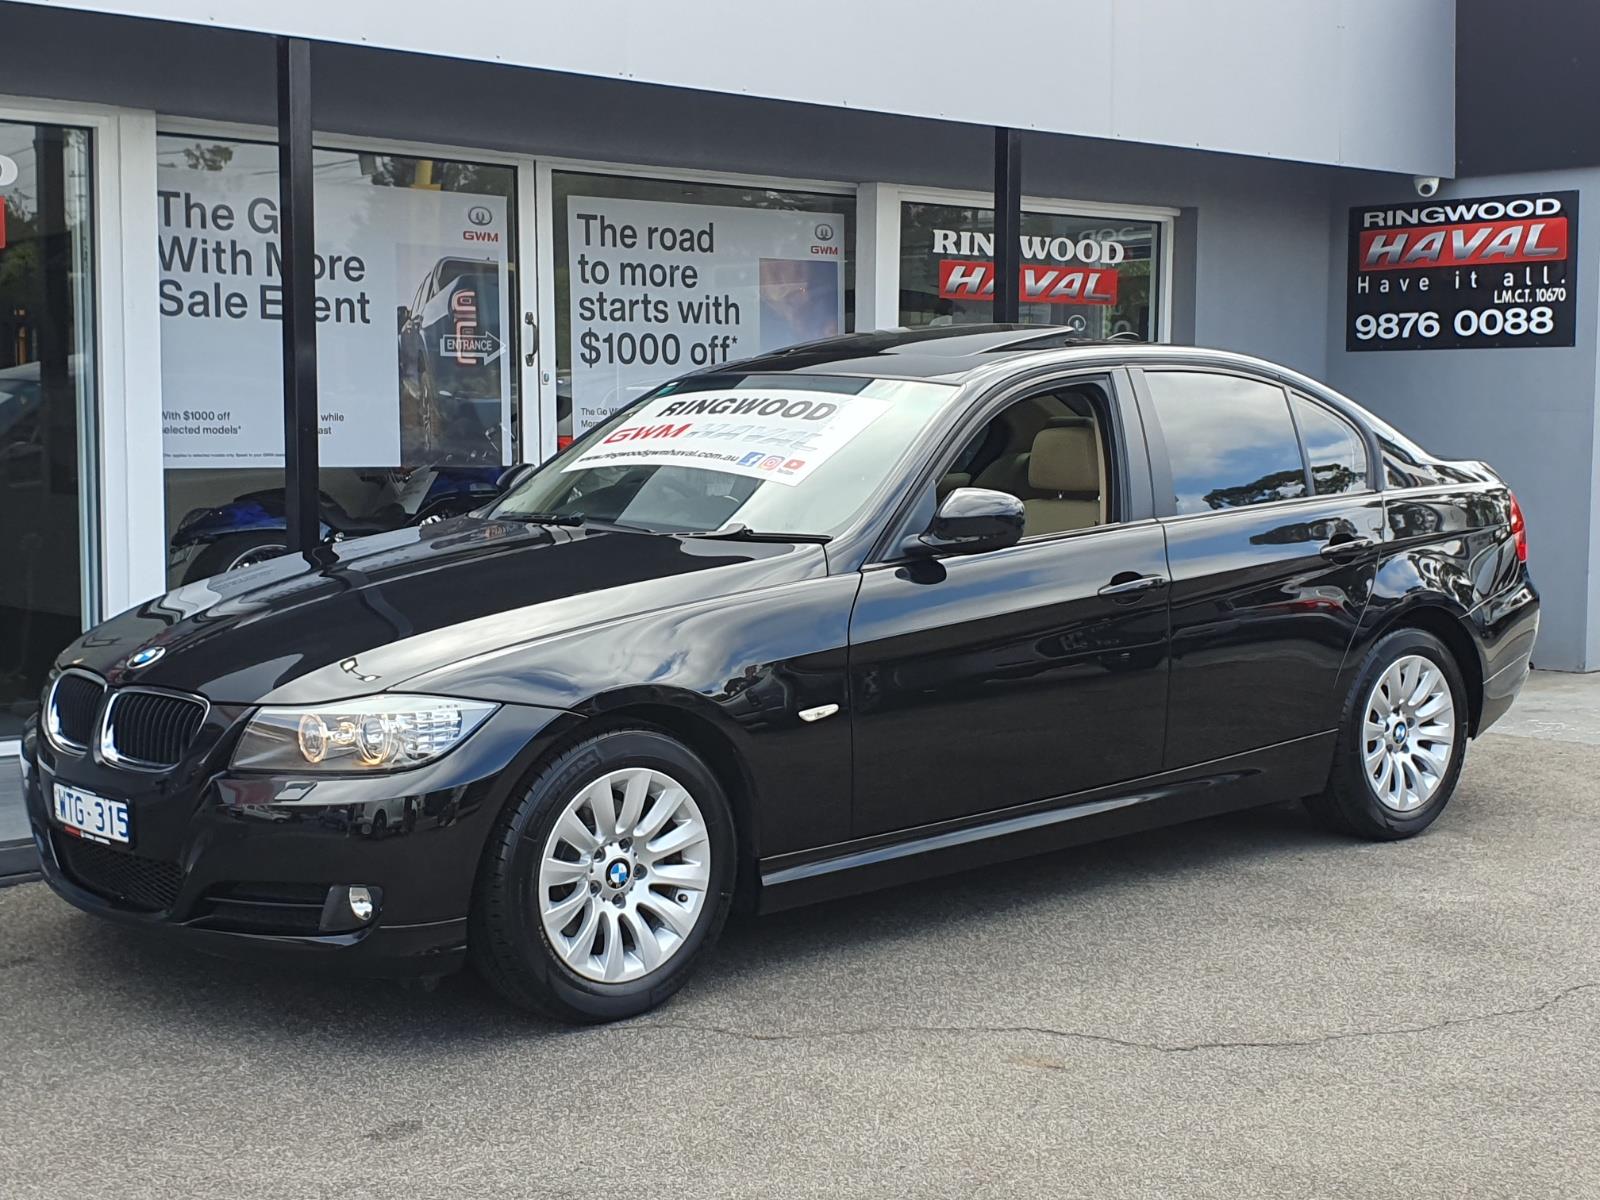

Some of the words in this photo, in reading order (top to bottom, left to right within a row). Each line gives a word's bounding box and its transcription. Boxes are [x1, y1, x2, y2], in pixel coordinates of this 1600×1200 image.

[157, 190, 235, 231] The
[247, 197, 279, 234] G
[1363, 198, 1562, 228] RINGWOOD
[463, 230, 499, 243] GWM
[576, 213, 637, 249] The
[647, 222, 714, 253] road
[932, 229, 1125, 265] RINWOOD
[1365, 223, 1560, 264] HAVAL
[158, 234, 253, 276] With
[266, 241, 366, 282] ore
[810, 245, 839, 256] GWM
[577, 253, 610, 285] to
[619, 264, 698, 289] more
[944, 265, 1112, 301] HVAL
[1357, 275, 1430, 295] Have
[1455, 270, 1478, 289] it
[1503, 265, 1566, 287] all.
[159, 279, 248, 319] Sale
[260, 284, 371, 324] Eent
[579, 291, 670, 324] starts
[678, 294, 740, 325] with
[1535, 287, 1567, 302] 10670
[1355, 311, 1441, 340] 9876
[1453, 306, 1554, 337] 0088
[447, 338, 493, 352] ENTRANCE
[580, 327, 680, 368] $1000
[183, 410, 215, 421] $1000
[217, 410, 231, 420] off
[320, 412, 345, 421] while
[580, 407, 595, 416] The
[596, 407, 608, 416] Go
[656, 398, 838, 421] RINGWOOD
[603, 423, 693, 444] GWM
